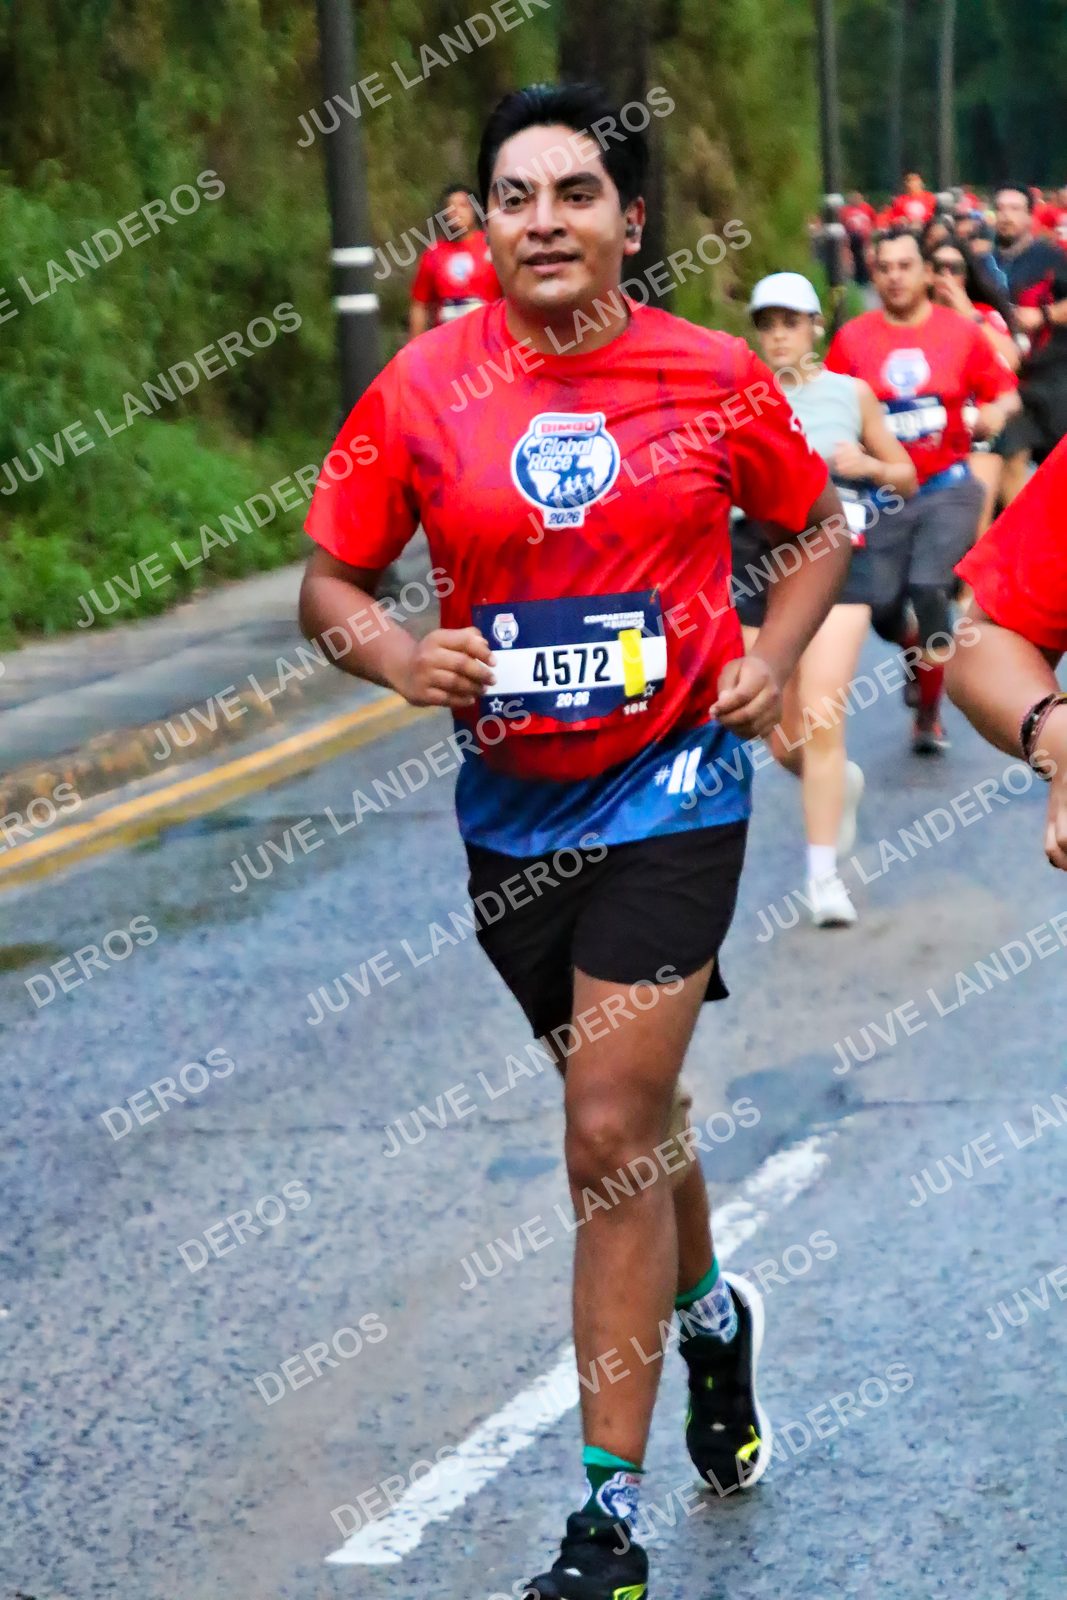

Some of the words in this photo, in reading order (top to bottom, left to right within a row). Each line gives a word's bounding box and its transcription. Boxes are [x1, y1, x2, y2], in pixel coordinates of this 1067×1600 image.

[540, 438, 594, 456] Global
[527, 453, 573, 471] Race
[548, 512, 580, 524] 2026
[533, 646, 611, 686] 4572
